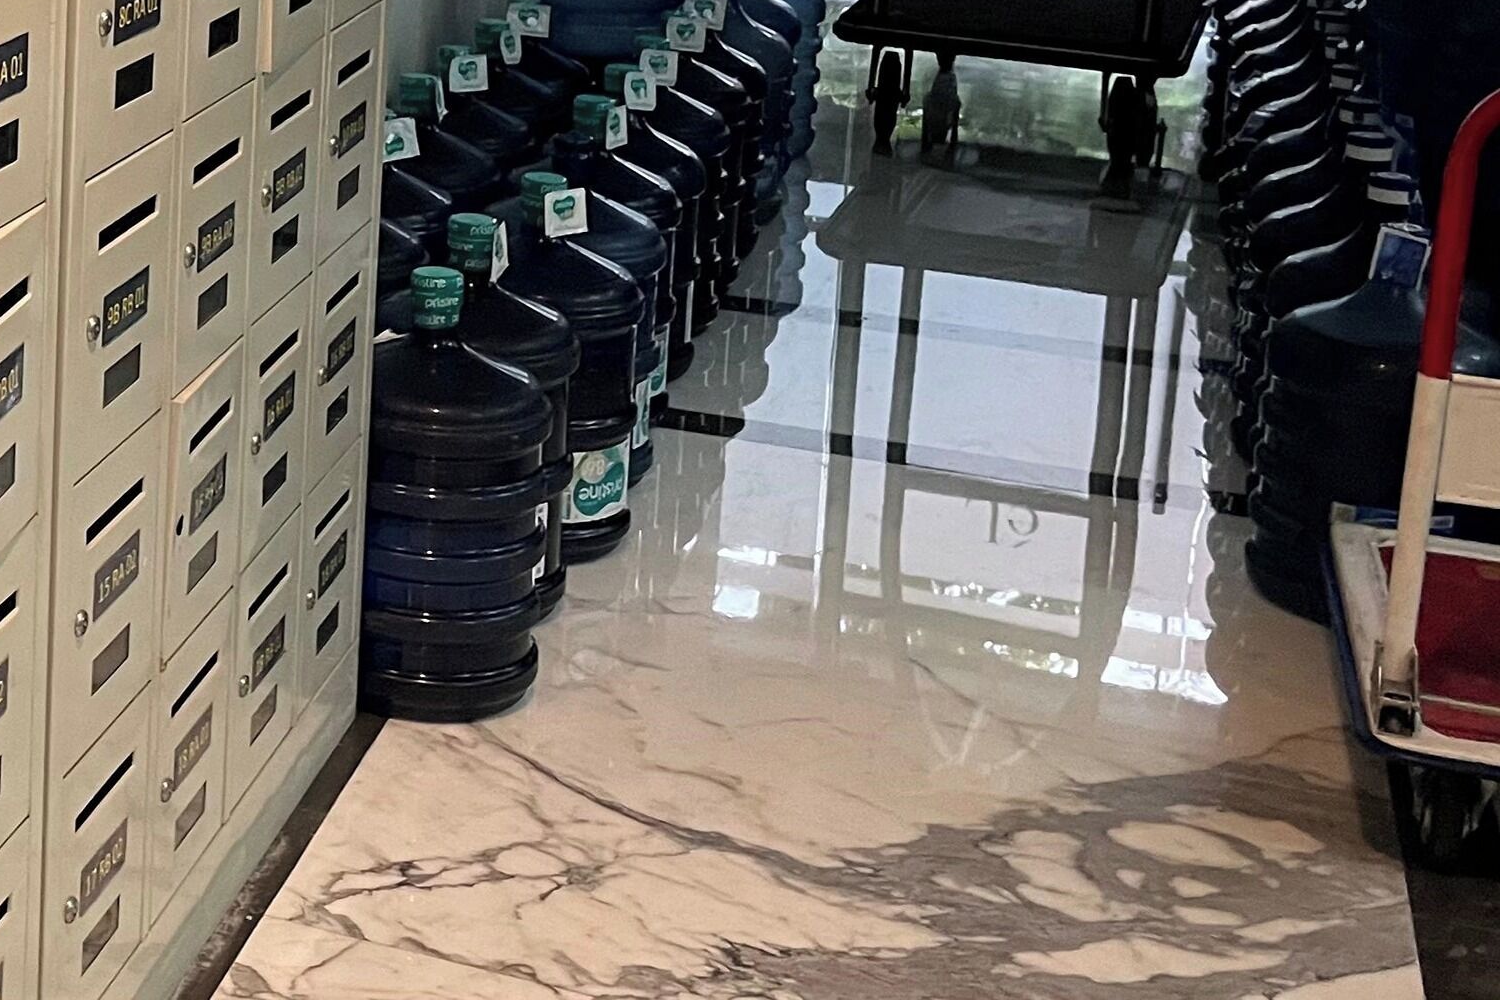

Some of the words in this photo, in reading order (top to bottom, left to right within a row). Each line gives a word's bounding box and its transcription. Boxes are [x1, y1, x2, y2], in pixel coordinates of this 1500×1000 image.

[118, 2, 133, 30] 8C
[10, 52, 24, 80] 01
[107, 301, 120, 330] 9B
[120, 293, 134, 316] RB
[98, 578, 112, 604] 15
[112, 564, 125, 589] RA
